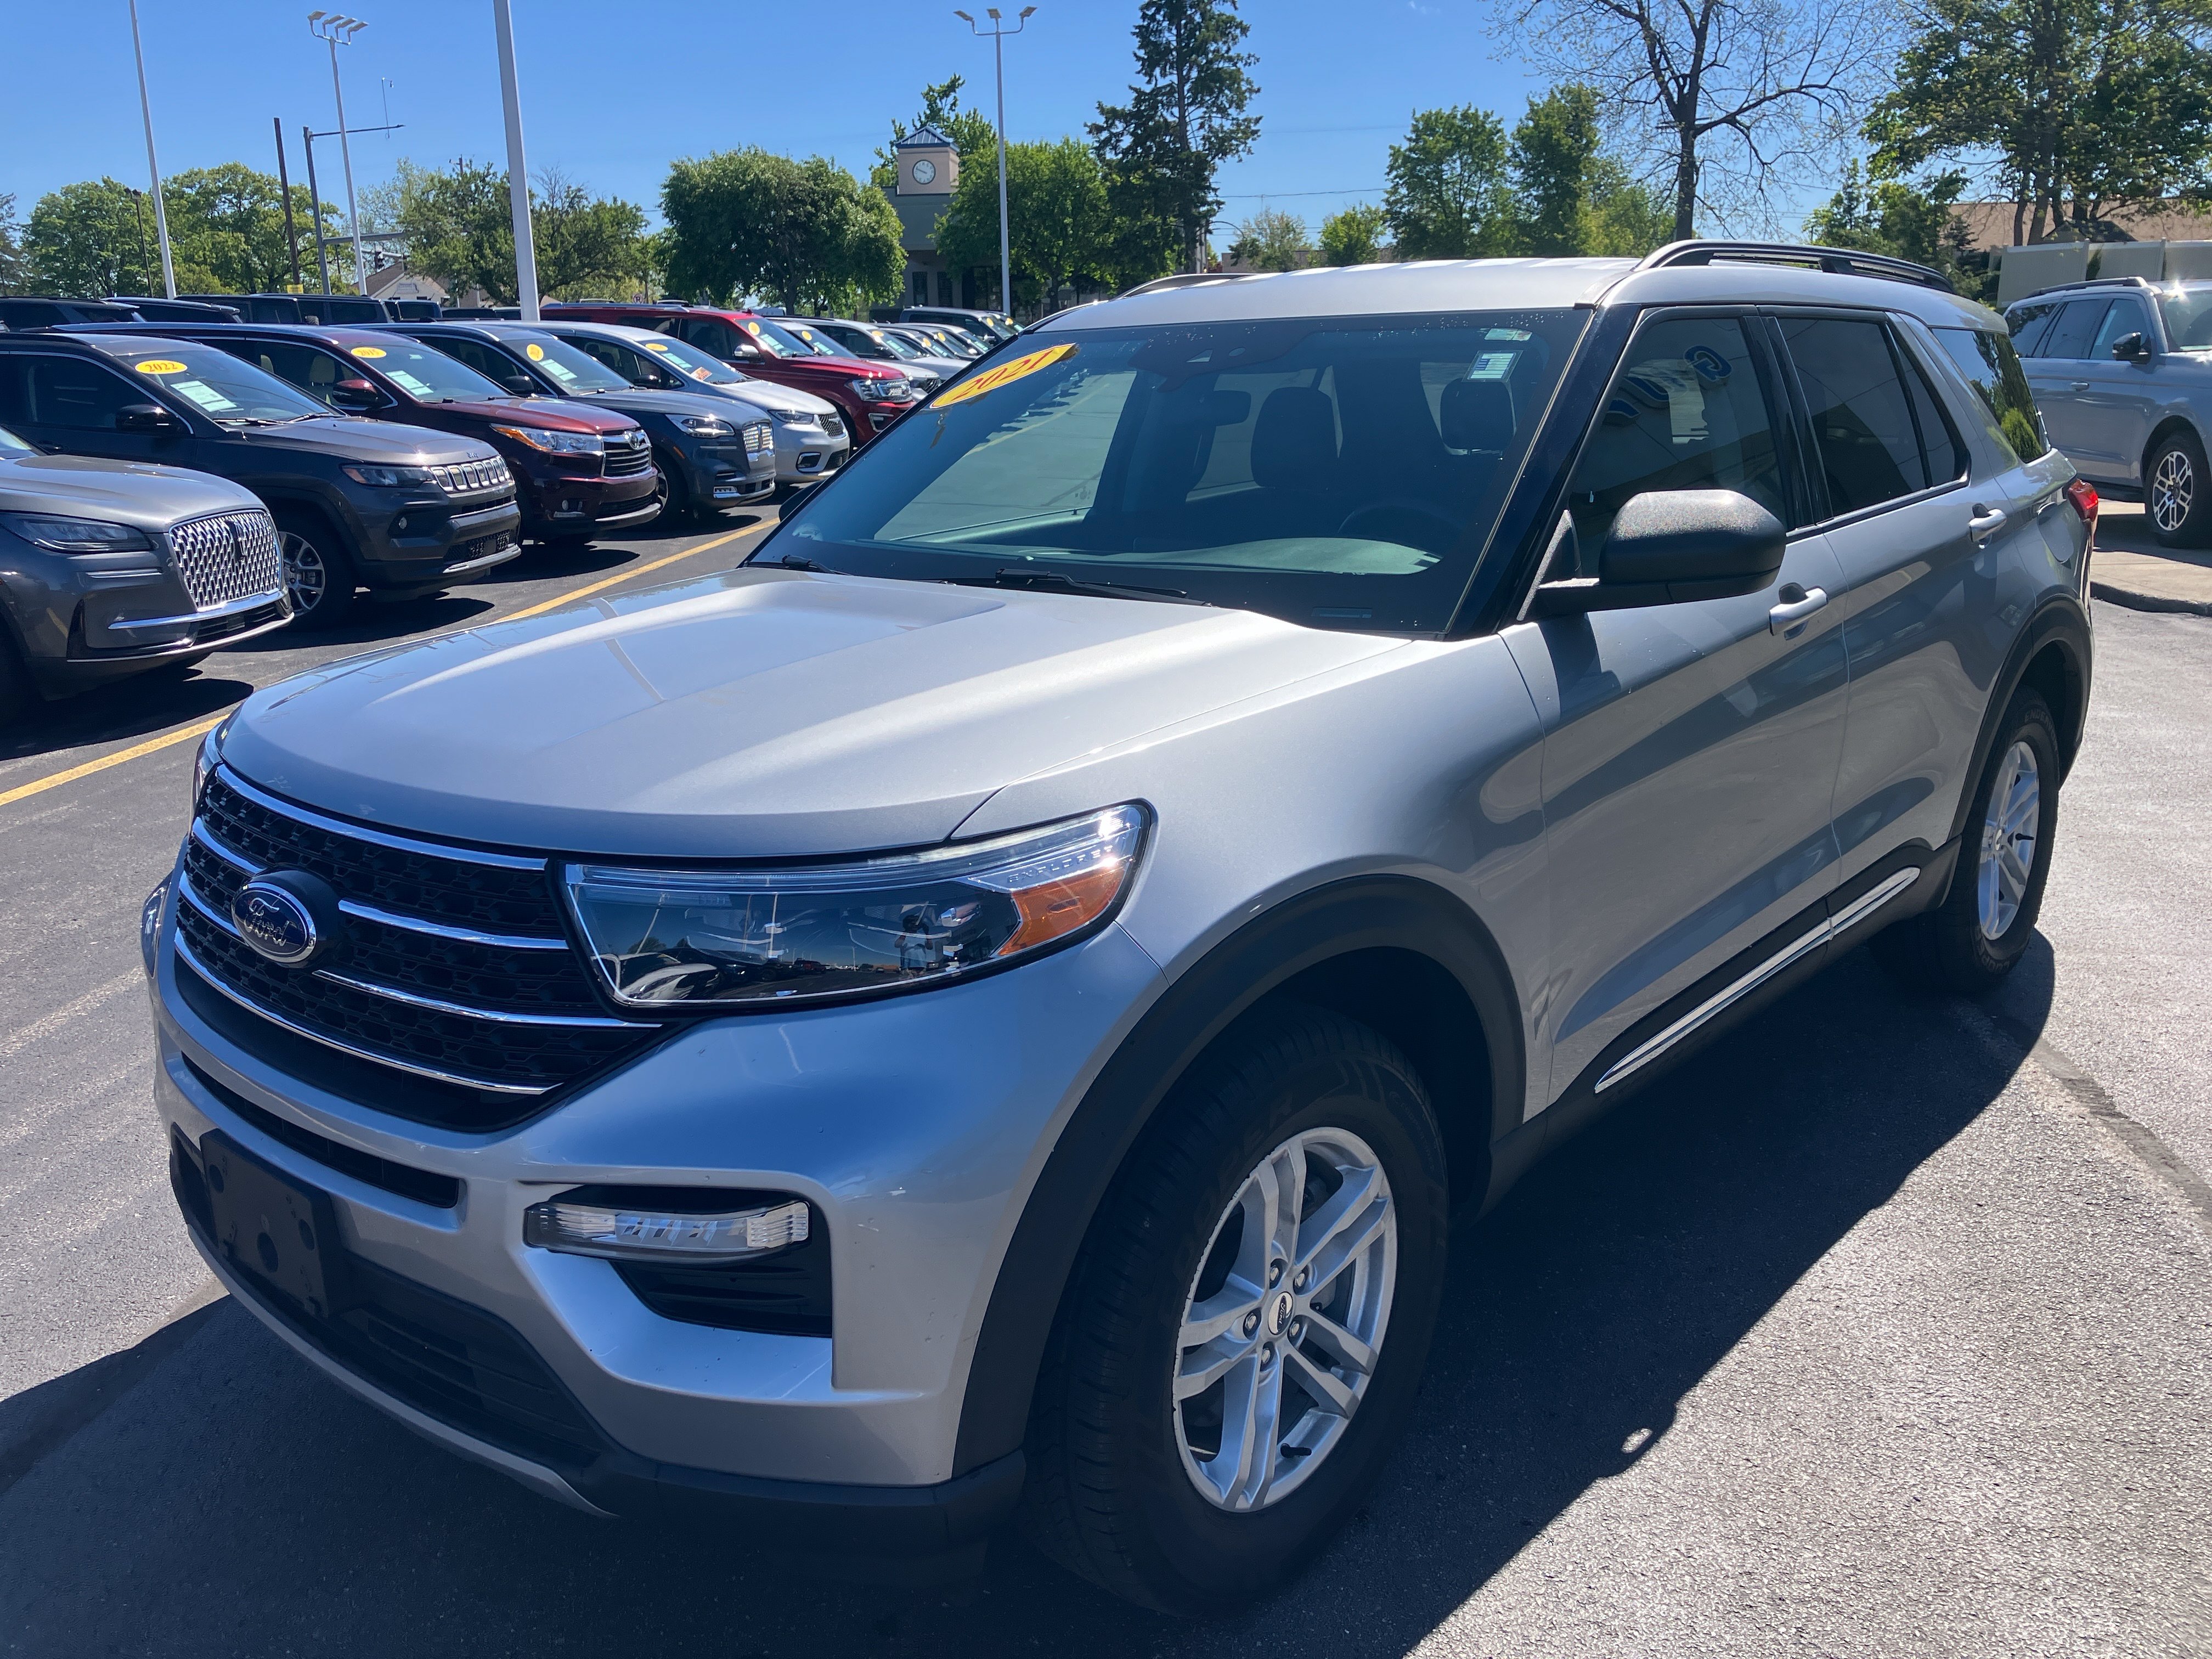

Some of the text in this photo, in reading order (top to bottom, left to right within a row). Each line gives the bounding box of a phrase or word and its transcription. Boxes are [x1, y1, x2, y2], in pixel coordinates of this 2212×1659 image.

[145, 363, 178, 372] 2022
[950, 349, 1053, 402] 2021
[244, 897, 290, 947] Ford
